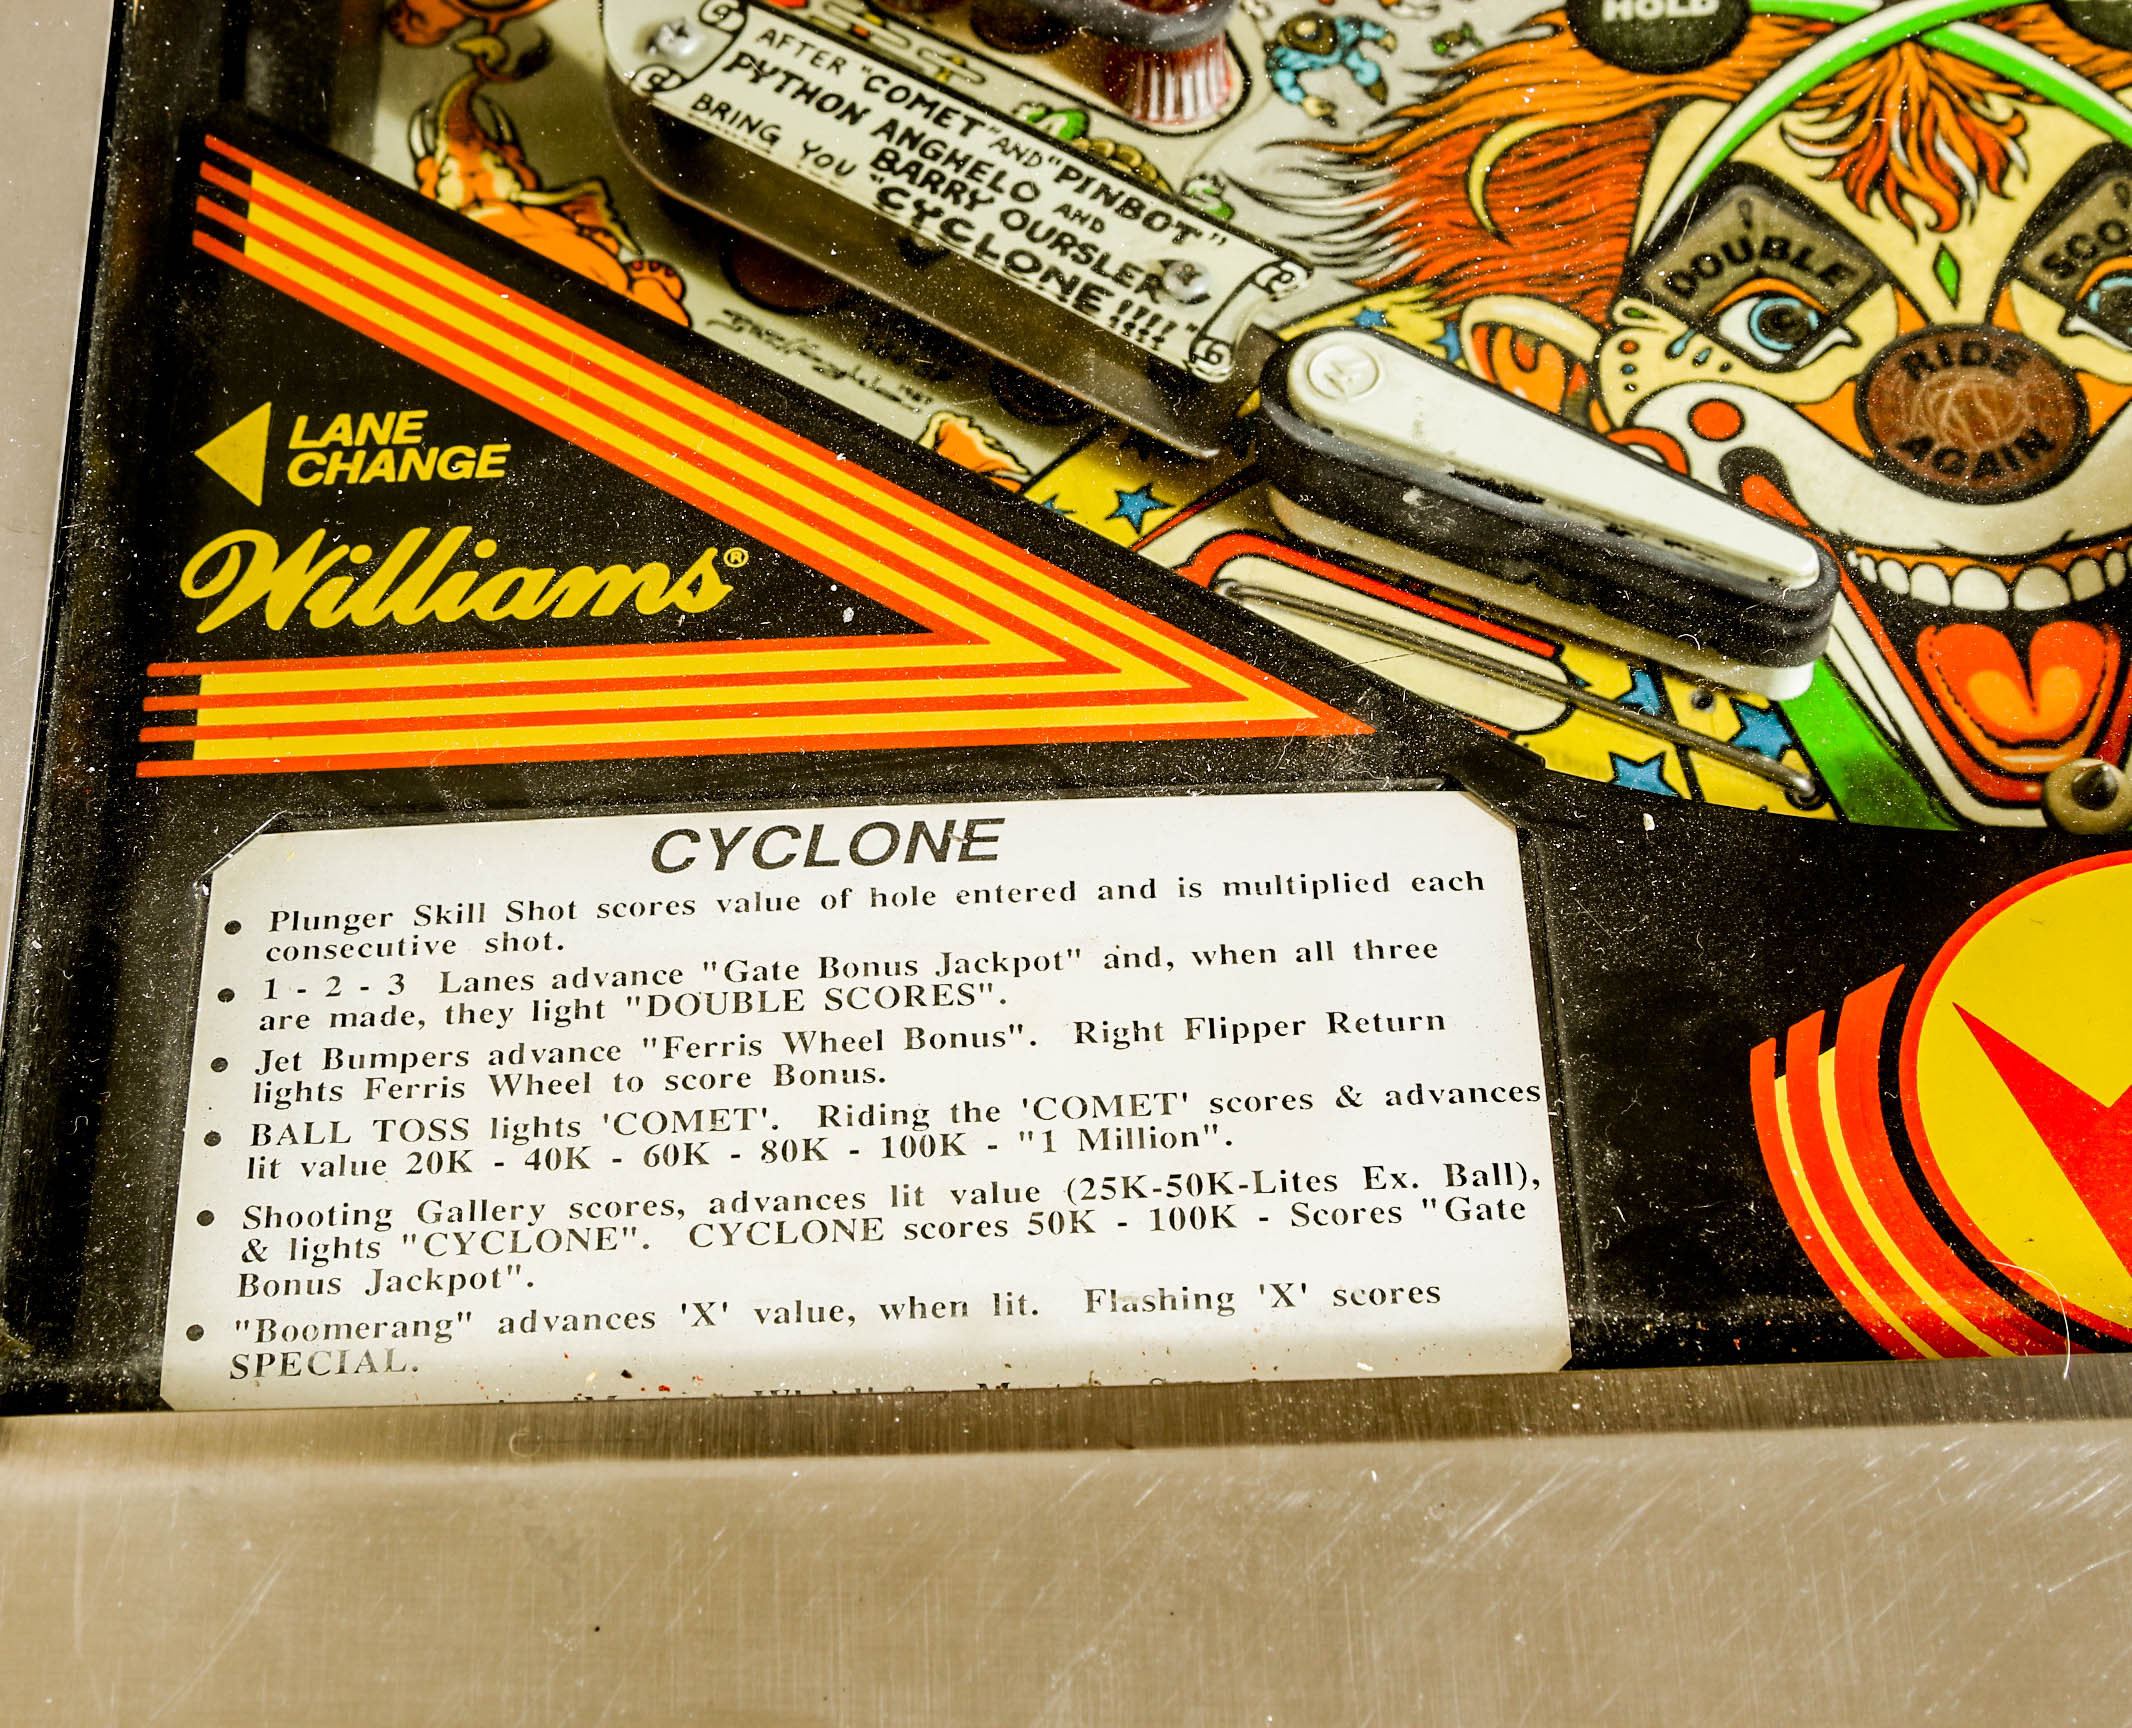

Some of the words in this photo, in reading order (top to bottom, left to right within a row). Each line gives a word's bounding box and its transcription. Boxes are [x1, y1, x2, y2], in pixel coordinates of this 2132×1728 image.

[756, 28, 847, 76] AFTER
[989, 136, 1043, 168] AND
[690, 93, 782, 146] BRING
[801, 139, 857, 177] YOU
[722, 51, 871, 126] PYTHON
[870, 118, 1041, 202] ANGHELO
[1053, 203, 1106, 234] AND
[870, 147, 995, 211] BARRY
[1000, 208, 1164, 304] OURSLER
[1667, 235, 1861, 300] DOUBLE
[1900, 340, 2032, 381] RIDE
[288, 409, 428, 449] LANE
[1897, 427, 2056, 479] AGAIN
[287, 444, 511, 487] CHANGE
[651, 818, 1005, 873] CYCLONE
[268, 910, 394, 936] Plunger
[413, 902, 486, 927] Skill
[505, 900, 576, 923] Shot
[596, 899, 696, 919] scores
[716, 891, 801, 914] value
[820, 887, 853, 910] of
[870, 885, 937, 908] hole
[956, 880, 1076, 905] entered
[1097, 877, 1157, 901] and
[1178, 876, 1202, 899] is
[1223, 871, 1390, 900] multiplied
[1411, 870, 1485, 892] each
[263, 977, 278, 1000] 1
[325, 975, 342, 998] 2
[387, 973, 405, 996] 3
[438, 970, 534, 994] Lanes
[551, 966, 684, 990] advance
[703, 959, 800, 983] "Gate
[818, 956, 918, 979] Bonus
[935, 947, 1081, 978] Jackpot"
[1103, 945, 1174, 972] and,
[1191, 943, 1277, 966] when
[1295, 940, 1334, 963] all
[1353, 939, 1438, 961] three
[265, 936, 457, 963] consecutive
[484, 931, 564, 954] shot.
[259, 1014, 311, 1032] are
[329, 1004, 426, 1031] made,
[445, 1002, 514, 1030] they
[531, 998, 605, 1028] light
[626, 988, 805, 1018] "DOUBLE
[824, 982, 1007, 1012] SCORES".
[254, 1049, 302, 1076] Jet
[321, 1047, 469, 1074] Bumpers
[488, 1042, 621, 1066] advance
[642, 1033, 762, 1060] "Ferris
[781, 1028, 884, 1055] Wheel
[903, 1023, 1037, 1051] Bonus".
[1073, 1020, 1165, 1051] Right
[1183, 1016, 1307, 1045] Flipper
[1325, 1011, 1446, 1035] Return
[249, 1120, 352, 1147] BALL
[372, 1117, 469, 1143] TOSS
[490, 1115, 581, 1146] lights
[603, 1107, 779, 1136] 'COMET'.
[817, 1102, 930, 1132] Riding
[950, 1100, 1001, 1124] the
[1022, 1091, 1188, 1121] 'COMET'
[1209, 1093, 1314, 1115] scores
[1335, 1084, 1363, 1109] &
[1385, 1082, 1541, 1107] advances
[253, 1080, 344, 1111] lights
[363, 1075, 465, 1101] Ferris
[488, 1071, 591, 1097] Wheel
[613, 1072, 644, 1093] to
[664, 1072, 752, 1092] score
[773, 1063, 886, 1087] Bonus.
[247, 1155, 281, 1180] lit
[300, 1154, 387, 1178] value
[405, 1149, 473, 1175] 20K
[524, 1145, 592, 1171] 40K
[643, 1141, 710, 1168] 60K
[760, 1137, 829, 1164] 80K
[881, 1132, 967, 1159] 100K
[1019, 1129, 1057, 1153] "1
[1077, 1123, 1233, 1152] Million".
[242, 1202, 393, 1233] Shooting
[417, 1199, 546, 1227] Gallery
[569, 1199, 685, 1221] scores,
[709, 1190, 866, 1215] advances
[891, 1183, 925, 1208] lit
[950, 1181, 1040, 1206] value
[1362, 1165, 1419, 1190] Ex.
[1442, 1161, 1540, 1191] Ball),
[241, 1238, 269, 1264] &
[289, 1236, 381, 1268] lights
[402, 1226, 650, 1257] "CYCLONE".
[689, 1217, 884, 1248] CYCLONE
[904, 1219, 1008, 1241] scores
[1027, 1209, 1096, 1236] 50K
[1149, 1204, 1237, 1232] 100K
[1291, 1201, 1403, 1228] Scores
[1421, 1196, 1526, 1222] "Gate
[237, 1273, 342, 1298] Bonus
[364, 1263, 534, 1297] Jackpot".
[235, 1311, 472, 1344] "Boomerang"
[498, 1309, 656, 1335] advances
[681, 1301, 728, 1327] 'X'
[753, 1299, 856, 1327] value,
[879, 1295, 968, 1321] when
[992, 1291, 1039, 1317] lit.
[1084, 1286, 1236, 1317] Flashing
[1259, 1282, 1307, 1308] 'X'
[1333, 1286, 1441, 1307] scores
[229, 1348, 419, 1380] SPECIAL.
